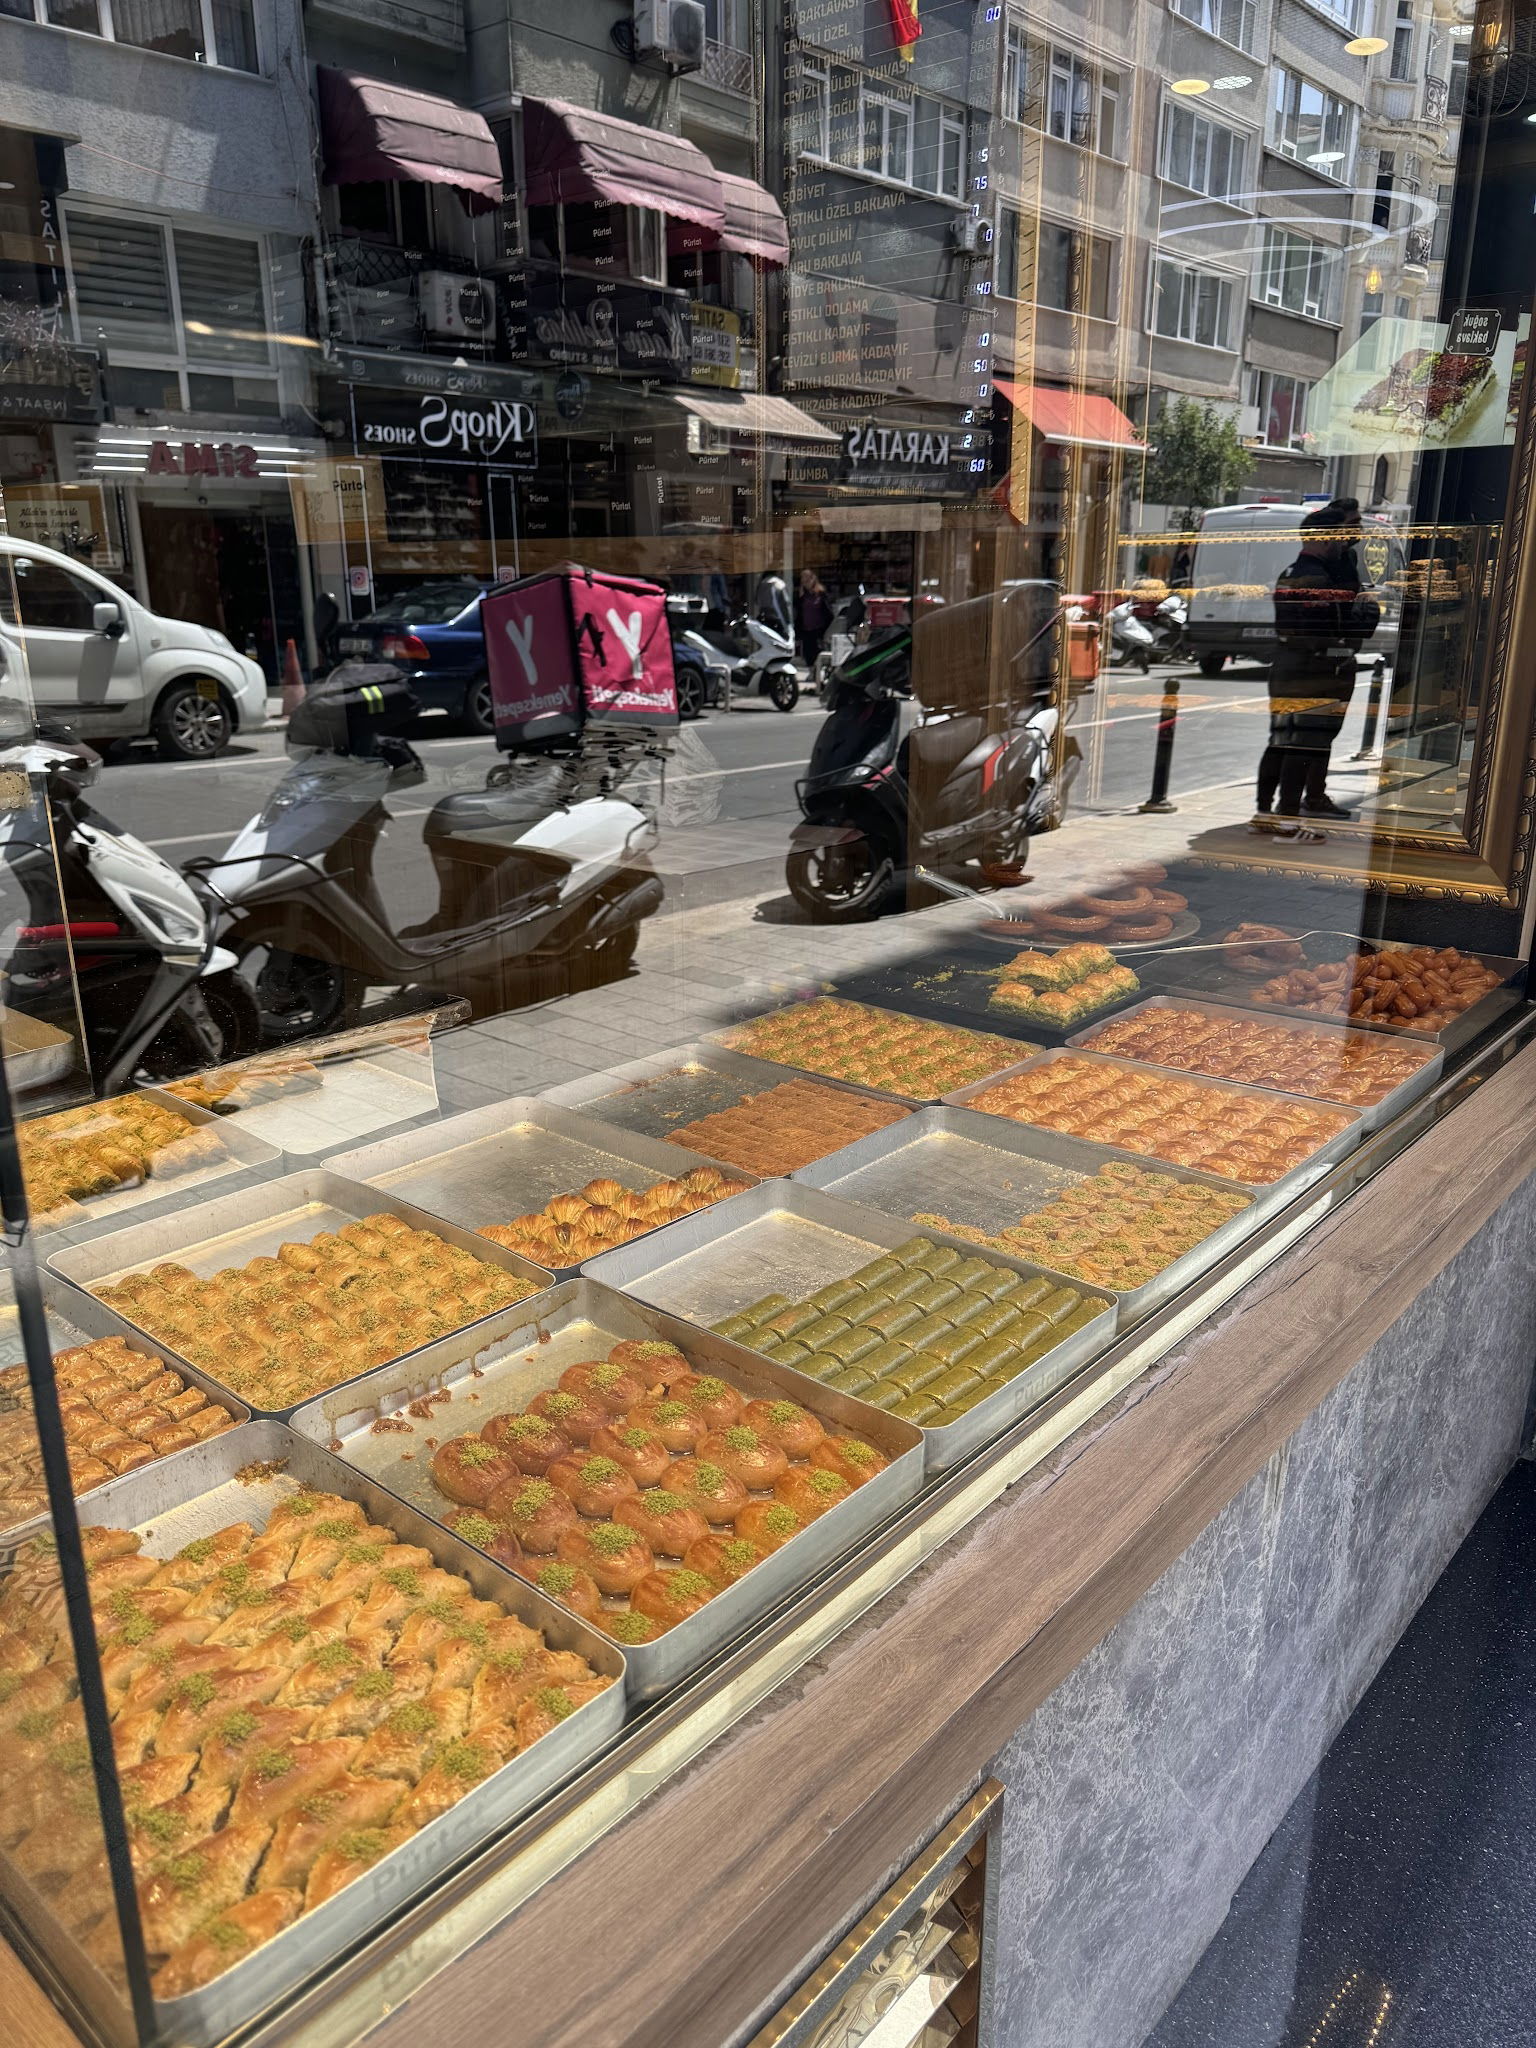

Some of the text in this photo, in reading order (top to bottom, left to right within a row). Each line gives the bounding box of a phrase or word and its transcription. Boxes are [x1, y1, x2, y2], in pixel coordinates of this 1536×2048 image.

[783, 14, 796, 29] EV
[823, 22, 850, 42] ÖZEL
[868, 60, 910, 81] YUVASI
[867, 83, 920, 108] BAKLAVA
[827, 120, 877, 144] BAKLAVA
[783, 183, 826, 208] ŞÖBİYET
[826, 203, 852, 220] ÖZEL
[854, 192, 905, 215] BAKLAVA
[786, 234, 817, 251] AVUÇ
[813, 250, 862, 271] BAKLAVA
[817, 275, 865, 294] BAKLAVA
[825, 299, 869, 317] DOLAMA
[825, 322, 871, 341] KADAYIF
[820, 348, 858, 365] BURMA
[861, 342, 909, 360] KADAYIF
[824, 372, 862, 387] BURMA
[864, 366, 913, 384] KADAYIF
[841, 392, 887, 409] KADAYIF
[781, 467, 829, 482] TULUMBA
